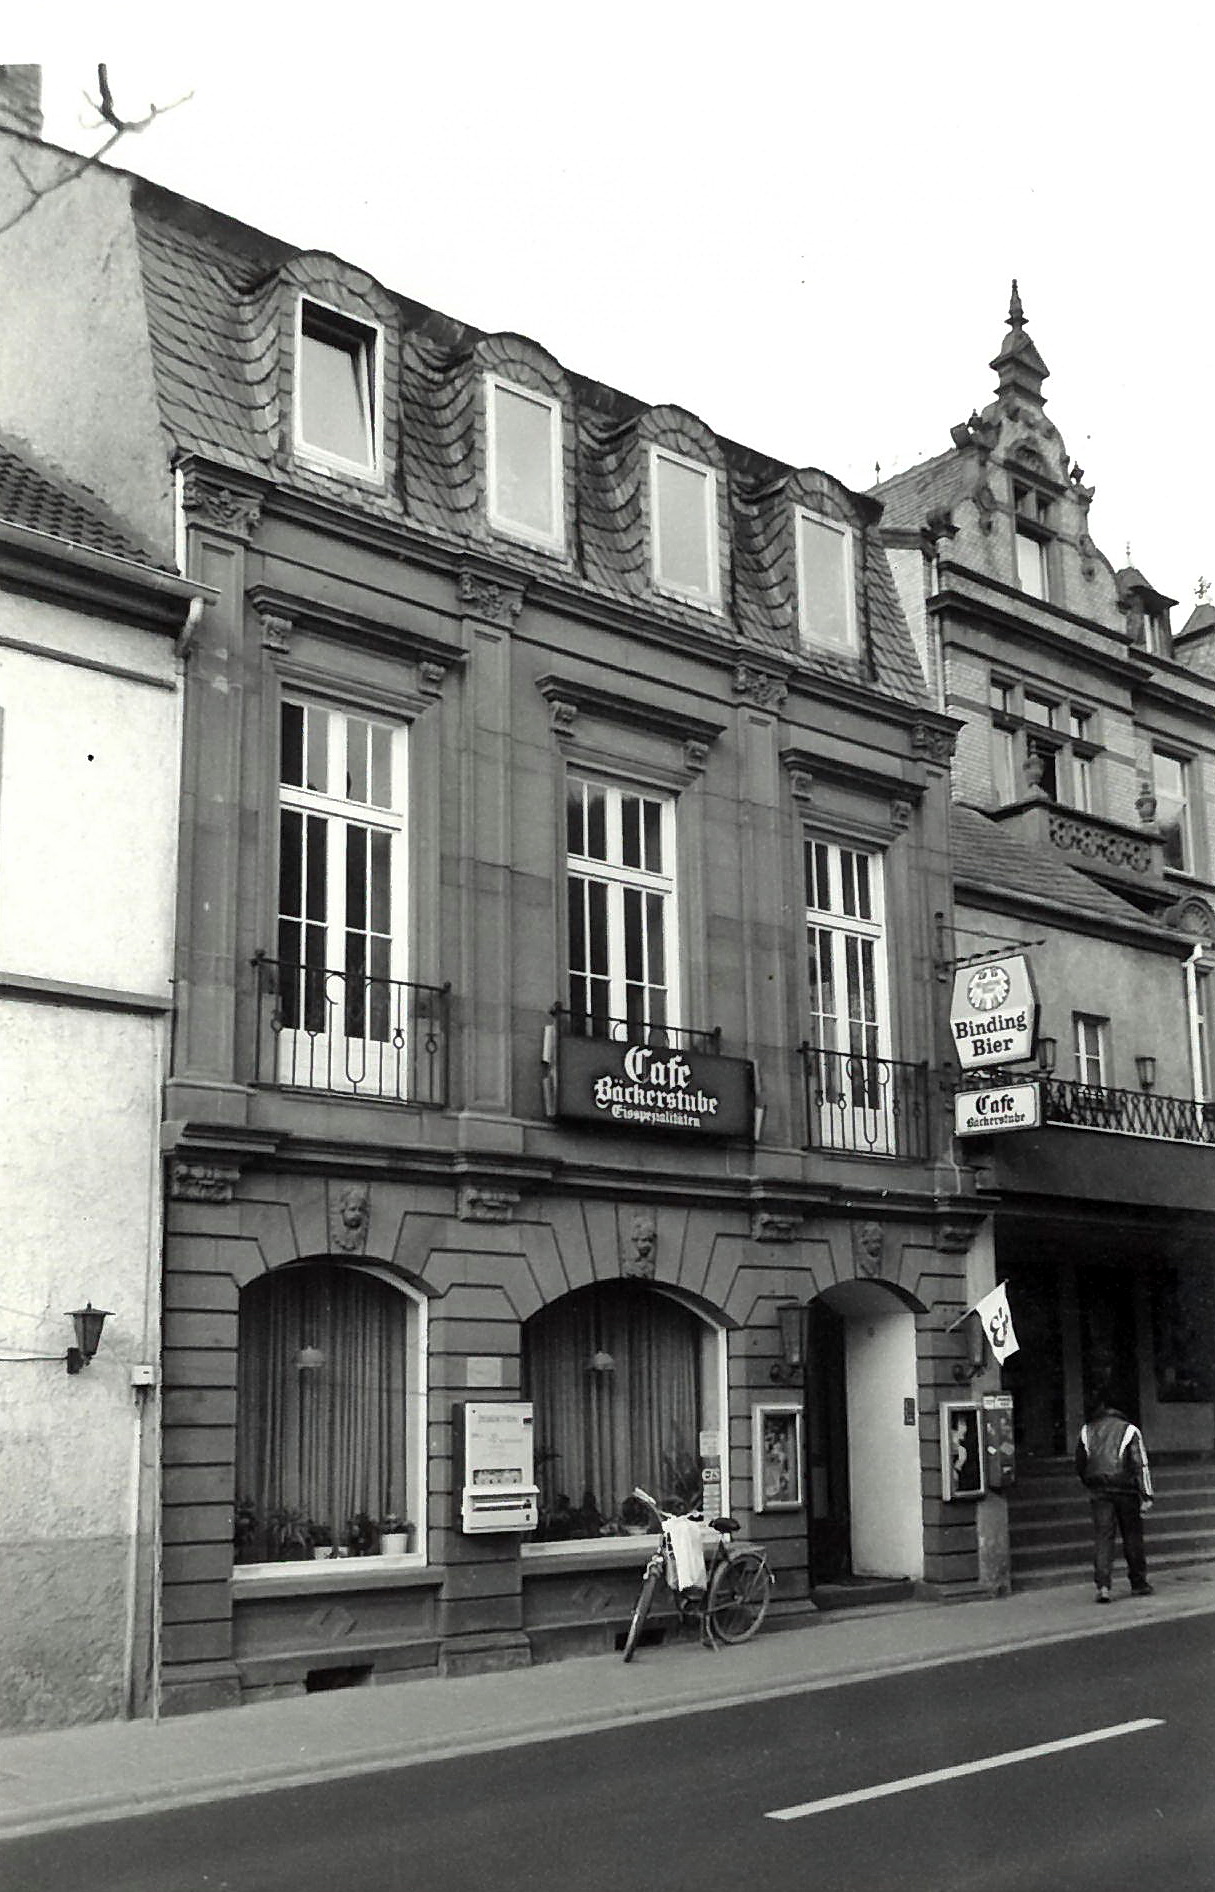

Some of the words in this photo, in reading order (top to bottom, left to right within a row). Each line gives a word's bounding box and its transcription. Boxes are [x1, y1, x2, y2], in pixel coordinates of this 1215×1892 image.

[955, 1011, 1028, 1039] Binding
[971, 1037, 1014, 1057] Bier
[624, 1045, 691, 1089] Cafe
[594, 1075, 718, 1115] Bäckerstube
[975, 1094, 1015, 1116] Cafe
[611, 1104, 701, 1128] Eisspezialitäten
